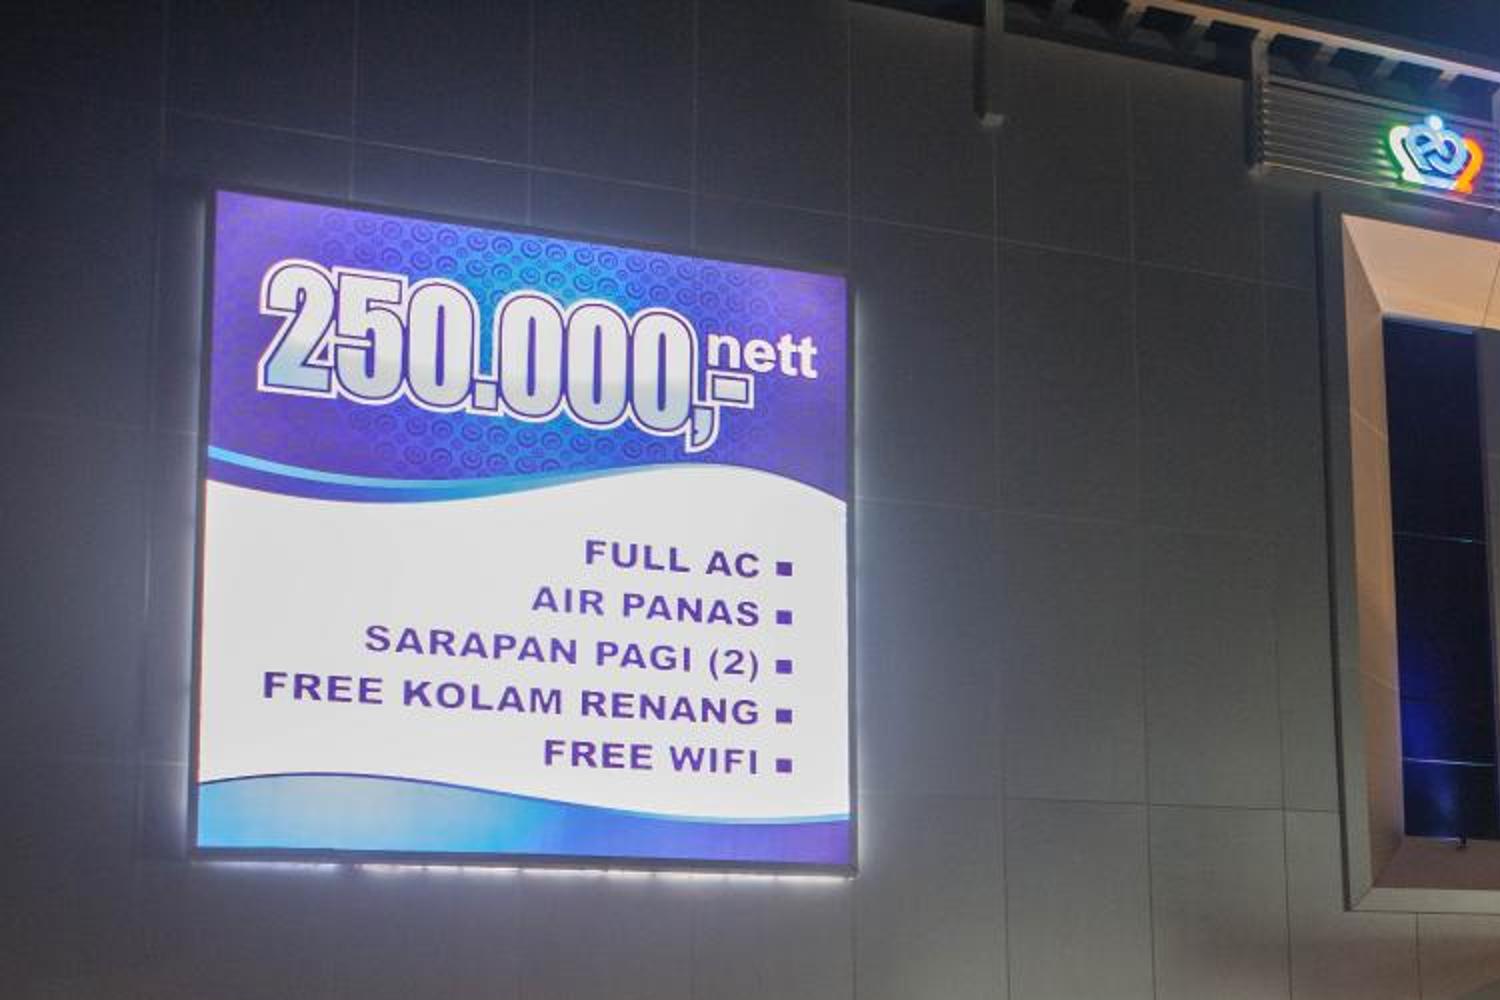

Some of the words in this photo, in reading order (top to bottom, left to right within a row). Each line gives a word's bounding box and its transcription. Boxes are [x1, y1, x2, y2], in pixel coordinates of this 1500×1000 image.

[707, 330, 819, 380] nett
[584, 539, 691, 573] FULL
[704, 550, 760, 580] AC
[531, 585, 605, 618] AIR
[621, 592, 760, 627] PANAS
[364, 624, 578, 665] SARAPAN
[595, 641, 692, 673] PAGI
[708, 647, 760, 684] (2)
[262, 671, 385, 705] FREE
[402, 679, 563, 716] KOLAM
[580, 690, 760, 726] RENANG
[543, 739, 653, 771] FREE
[668, 745, 759, 775] WIFI
